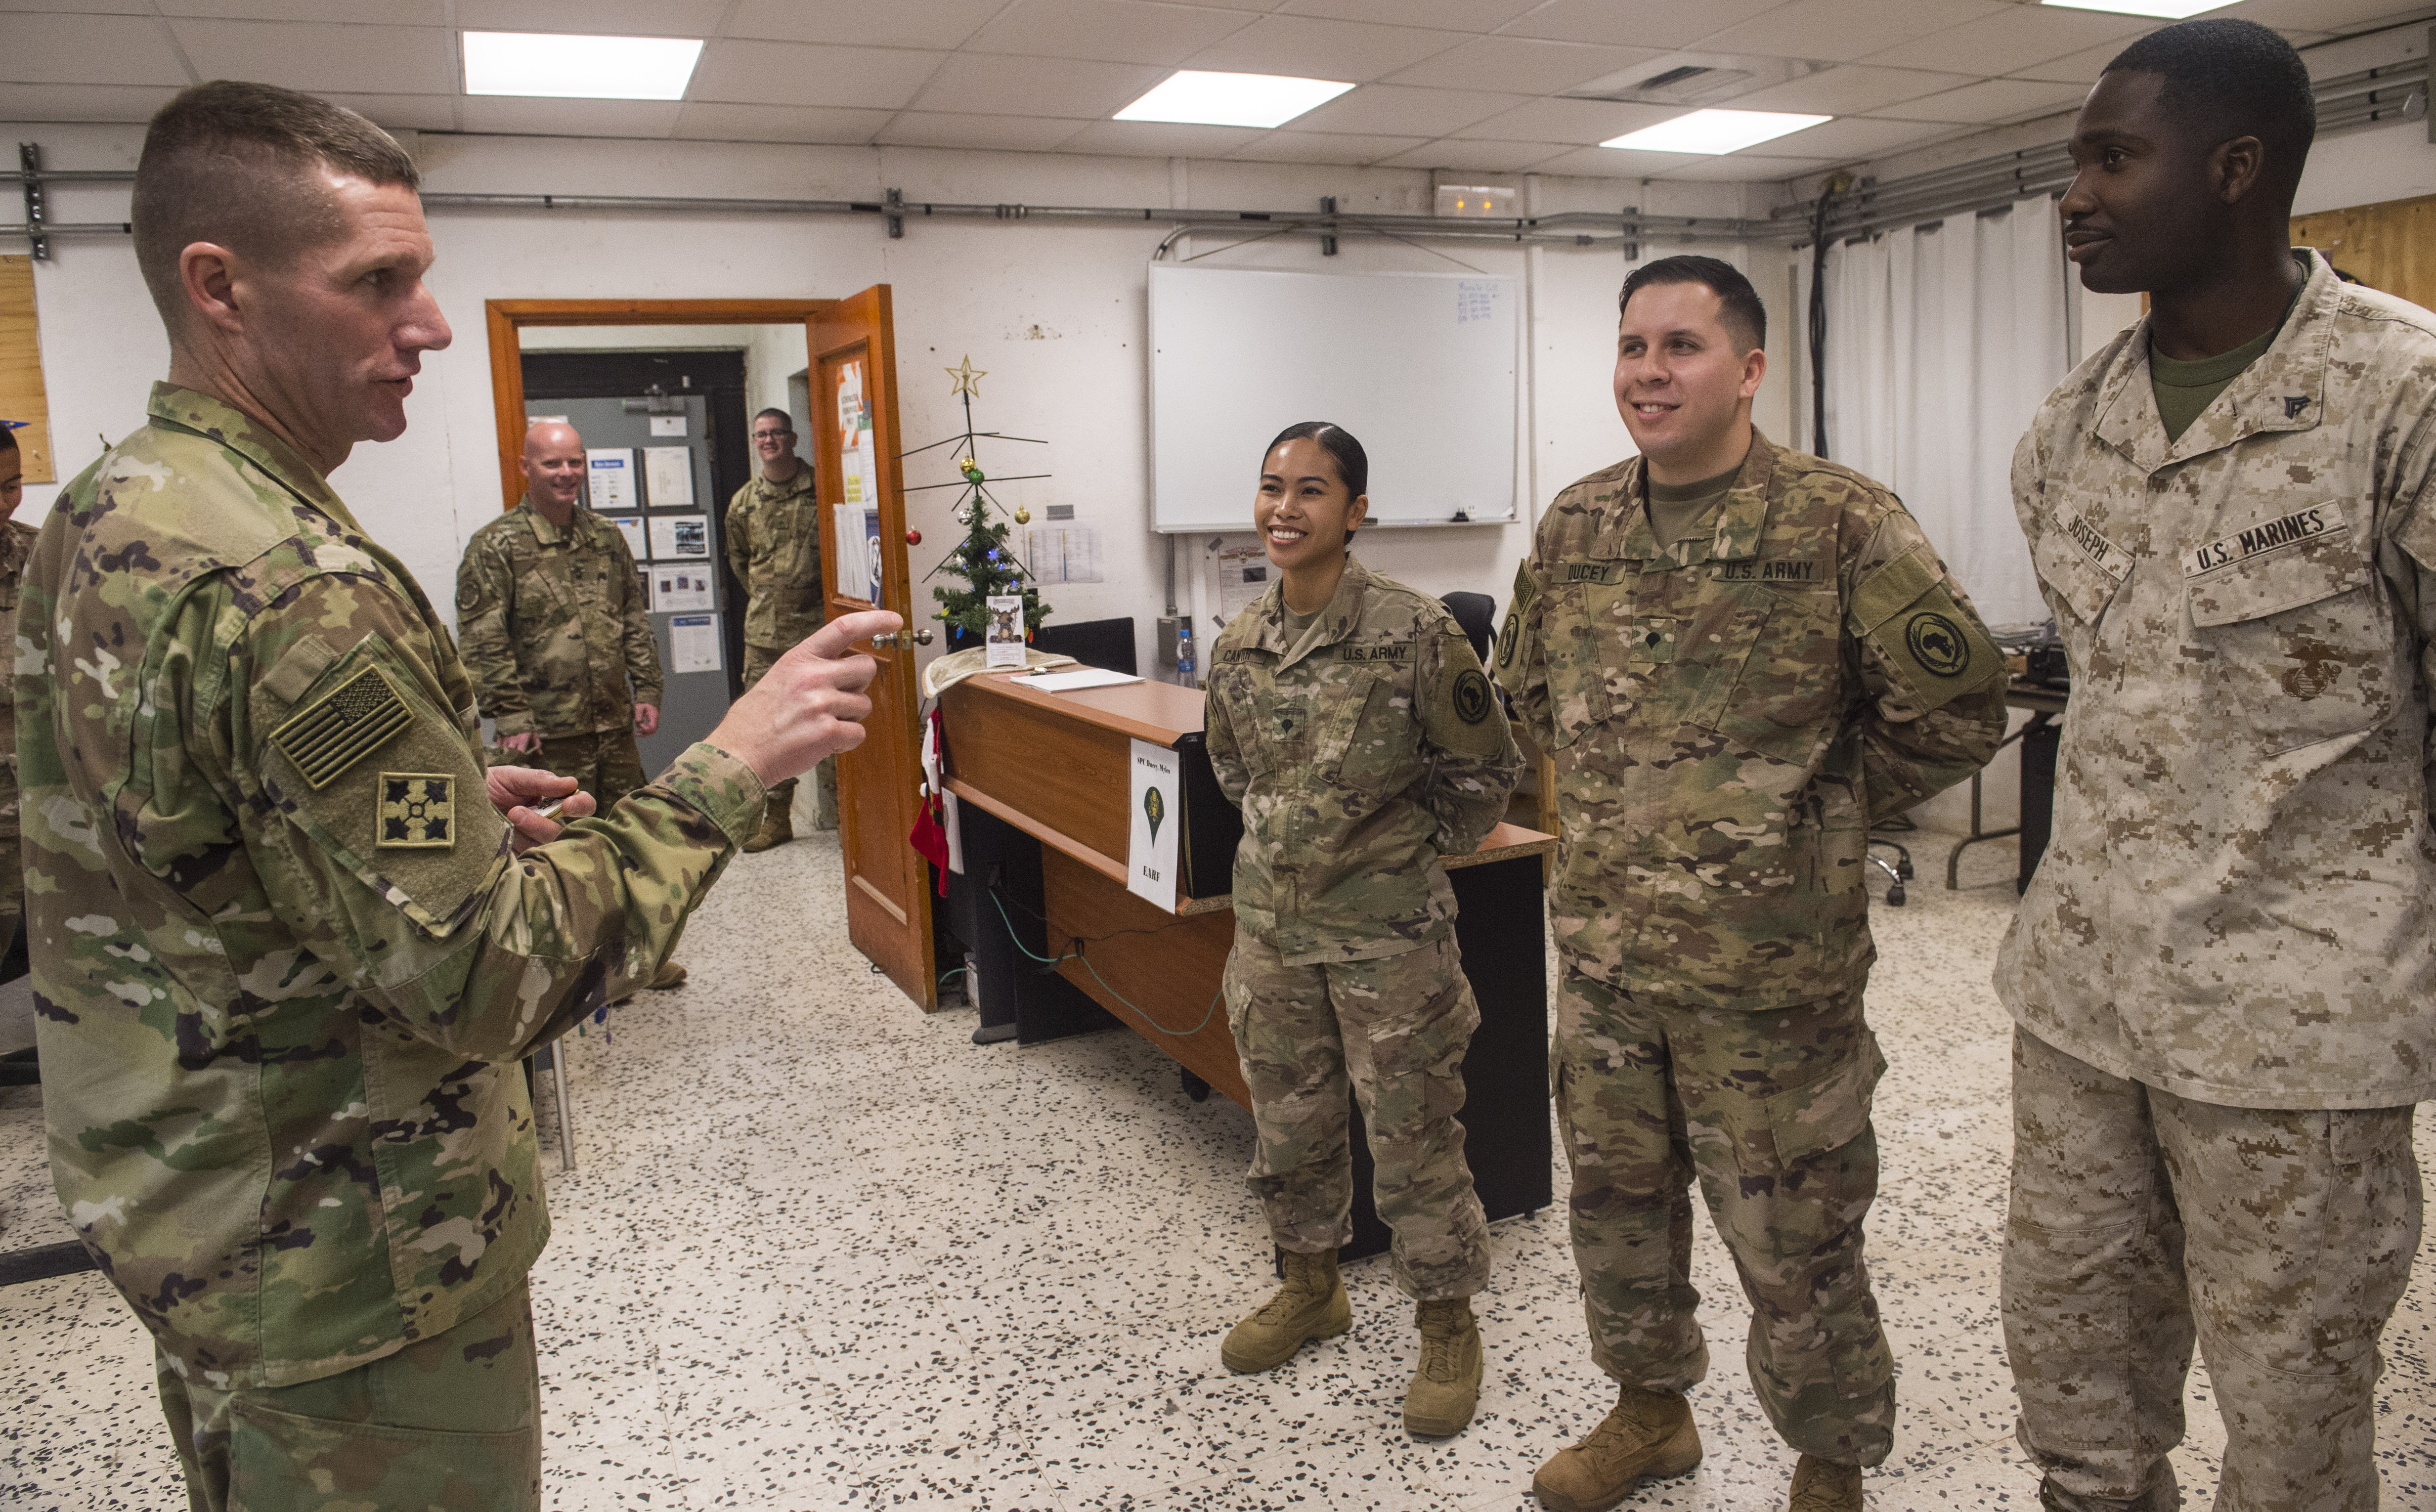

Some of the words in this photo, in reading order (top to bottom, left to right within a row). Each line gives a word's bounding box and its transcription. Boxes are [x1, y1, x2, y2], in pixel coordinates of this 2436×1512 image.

[2068, 515, 2109, 562] JOSEPH
[2196, 542, 2233, 570] U.S.
[2238, 509, 2325, 555] MARINES
[1568, 564, 1610, 581] DUCEY
[1724, 562, 1756, 579] U.S.
[1762, 561, 1814, 580] ARMY
[1343, 648, 1366, 661] U.S.
[1369, 646, 1407, 660] ARMY
[1137, 756, 1146, 766] SPC
[1159, 763, 1171, 775] Myles
[1143, 865, 1161, 882] EARF
